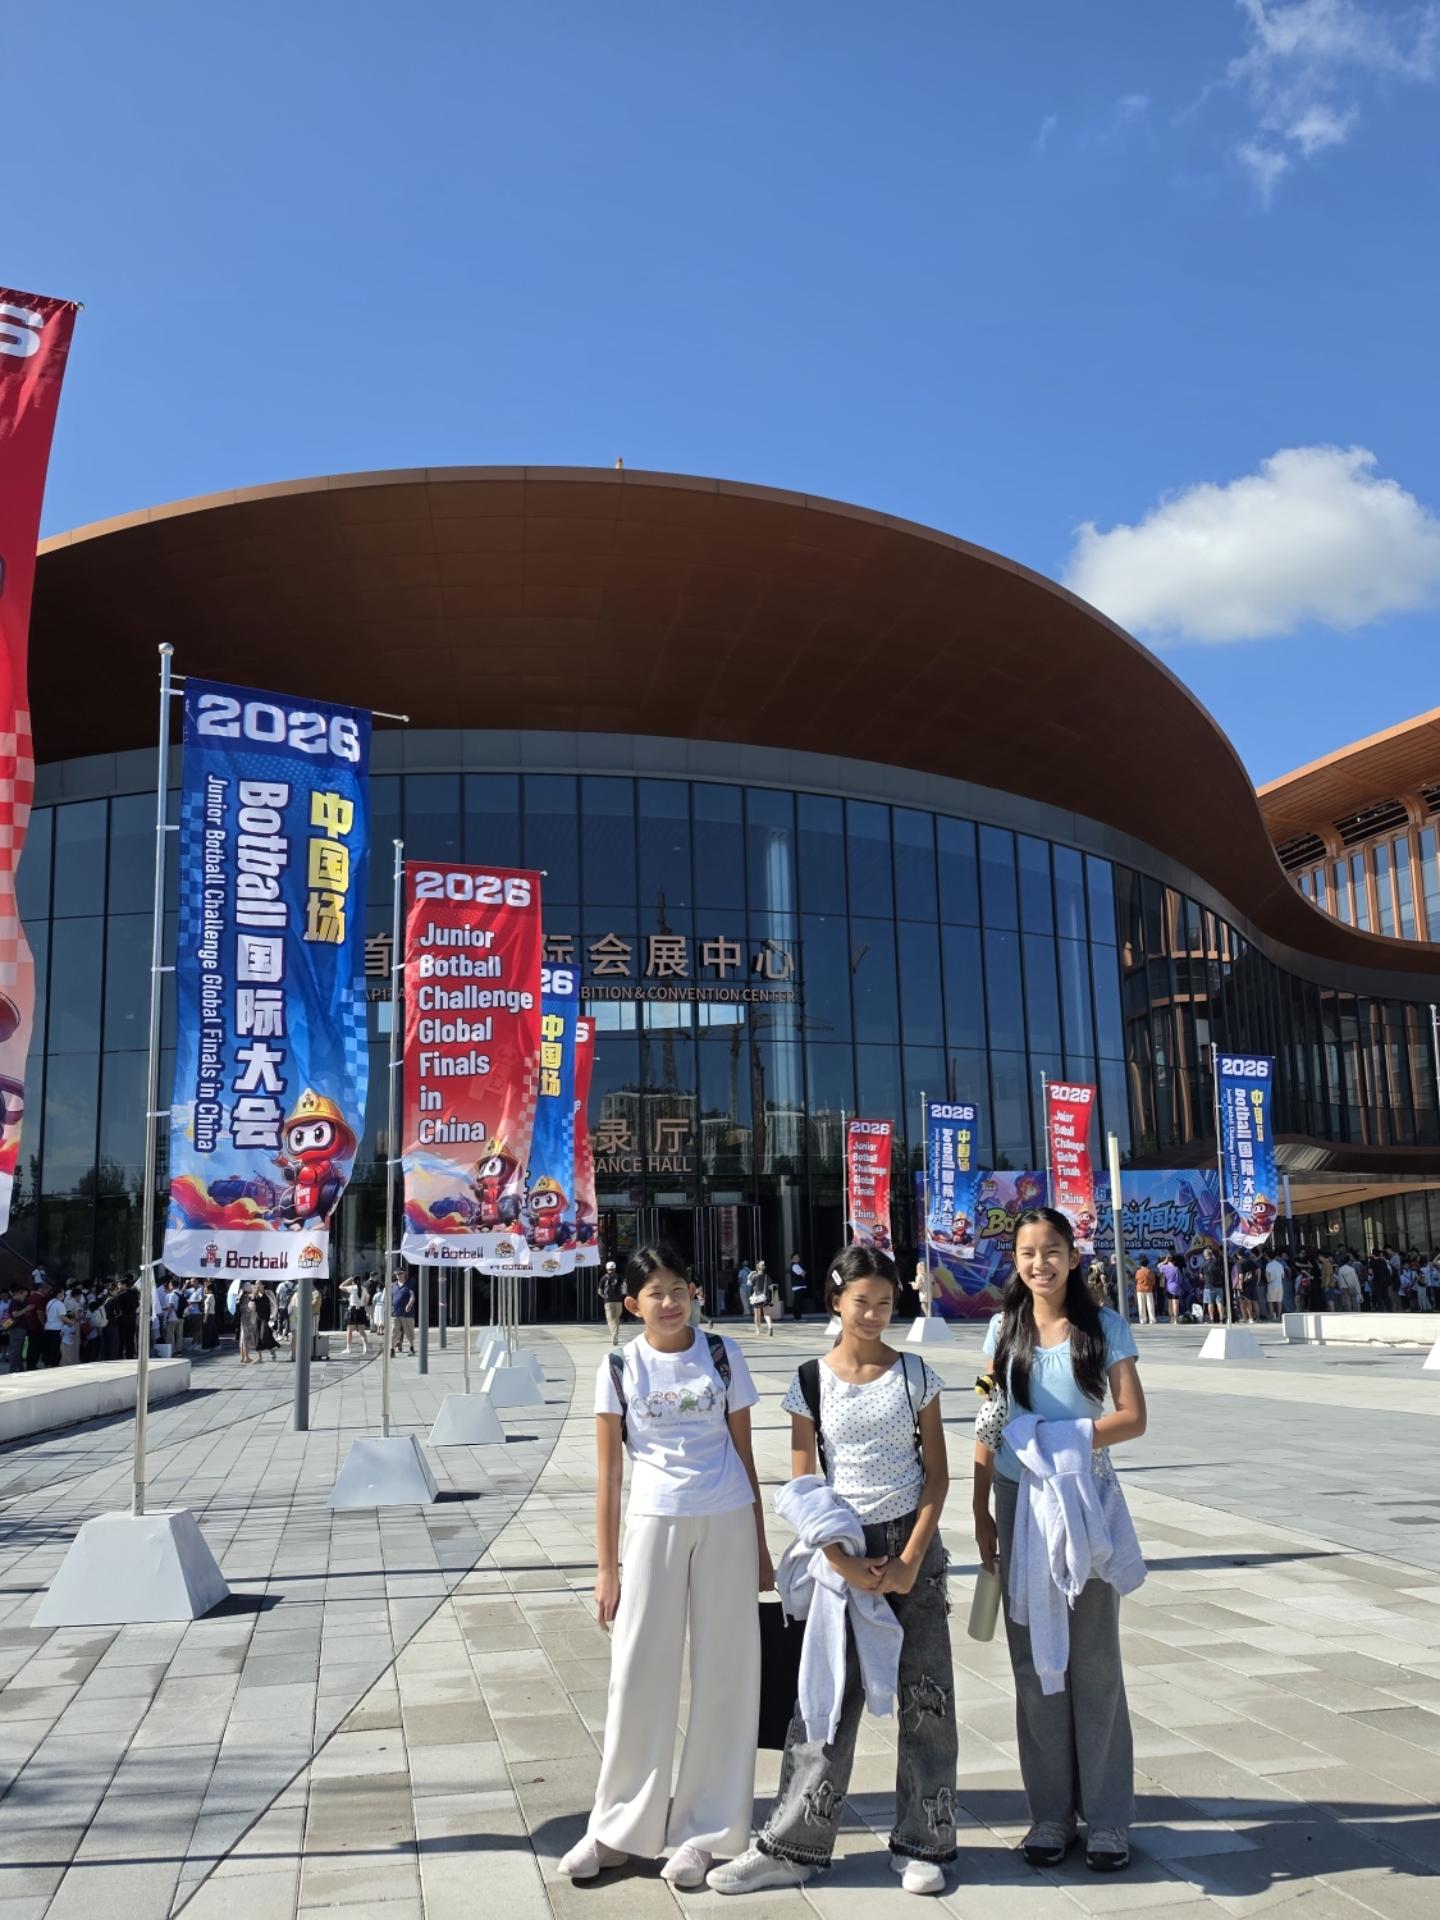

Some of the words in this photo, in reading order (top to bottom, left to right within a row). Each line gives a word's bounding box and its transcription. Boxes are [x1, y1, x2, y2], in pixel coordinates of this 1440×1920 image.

[195, 694, 361, 763] 2026
[207, 774, 229, 825] Junior
[205, 830, 226, 885] Botball
[236, 780, 289, 927] Botball
[303, 790, 354, 944] 中国场
[415, 871, 531, 907] 2026
[198, 888, 226, 969] Challenge
[419, 922, 495, 948] Junior
[365, 932, 795, 979] 首际会展中心
[419, 954, 501, 978] Botball
[202, 974, 223, 1024] Global
[419, 985, 533, 1013] Challenge
[581, 986, 632, 999] BITION
[634, 986, 645, 999] &
[648, 986, 739, 1000] CONVENTION
[742, 989, 795, 1002] CENTER
[232, 934, 283, 1148] 国际大会
[419, 1016, 492, 1044] Global
[201, 1027, 223, 1077] Finals
[419, 1050, 490, 1077] Finals
[540, 1013, 565, 1096] 中国场
[1222, 1058, 1268, 1077] 2026
[199, 1082, 222, 1098] in
[419, 1085, 442, 1111] in
[1050, 1084, 1091, 1103] 2026
[197, 1102, 220, 1150] China
[931, 1104, 973, 1120] 2026
[1235, 1088, 1252, 1138] Botball
[419, 1116, 485, 1144] China
[597, 1118, 690, 1154] 录厅
[849, 1121, 890, 1135] 2026
[853, 1141, 877, 1151] Junior
[593, 1157, 643, 1172] ANCE
[648, 1157, 692, 1172] HALL
[226, 1250, 288, 1269] Botball
